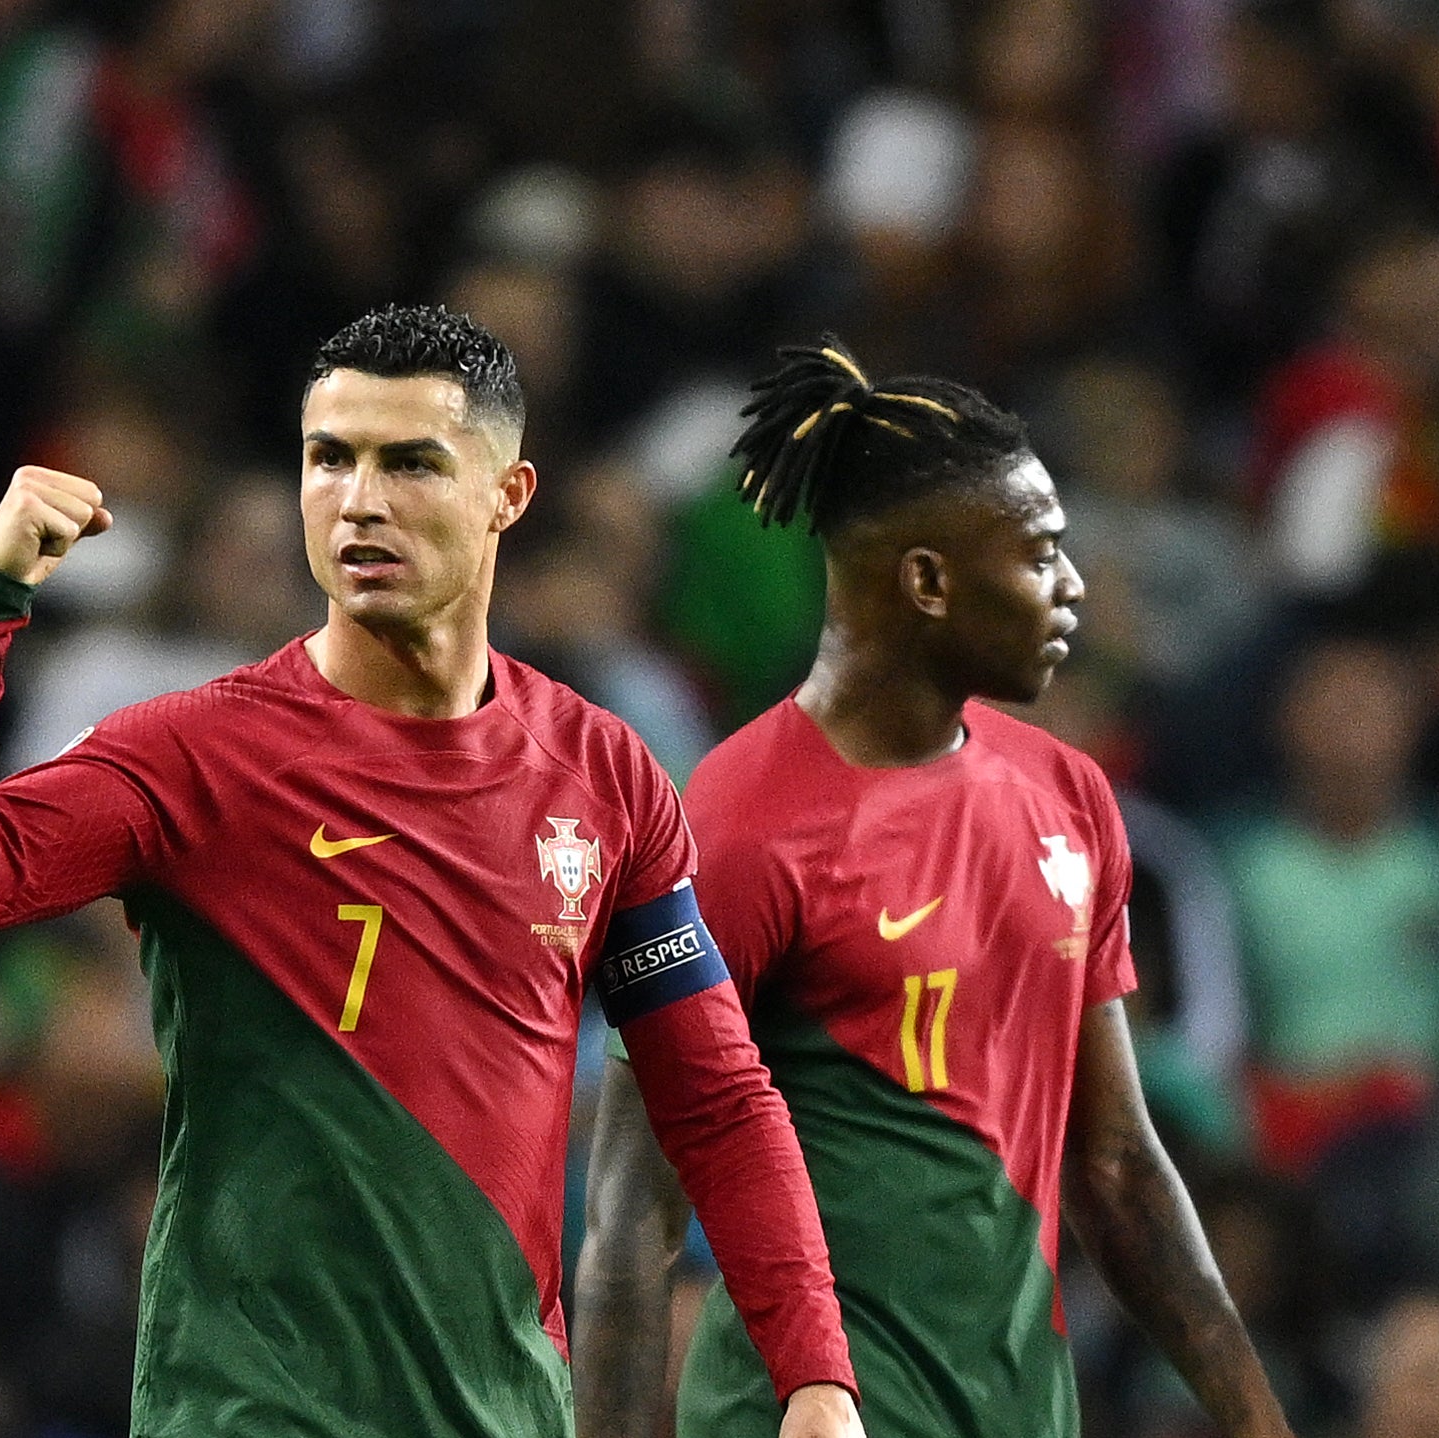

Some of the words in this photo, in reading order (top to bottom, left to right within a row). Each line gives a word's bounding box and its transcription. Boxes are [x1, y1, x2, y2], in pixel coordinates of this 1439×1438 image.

[336, 904, 384, 1032] 7
[621, 930, 701, 979] RESPECT
[899, 968, 958, 1094] 17
